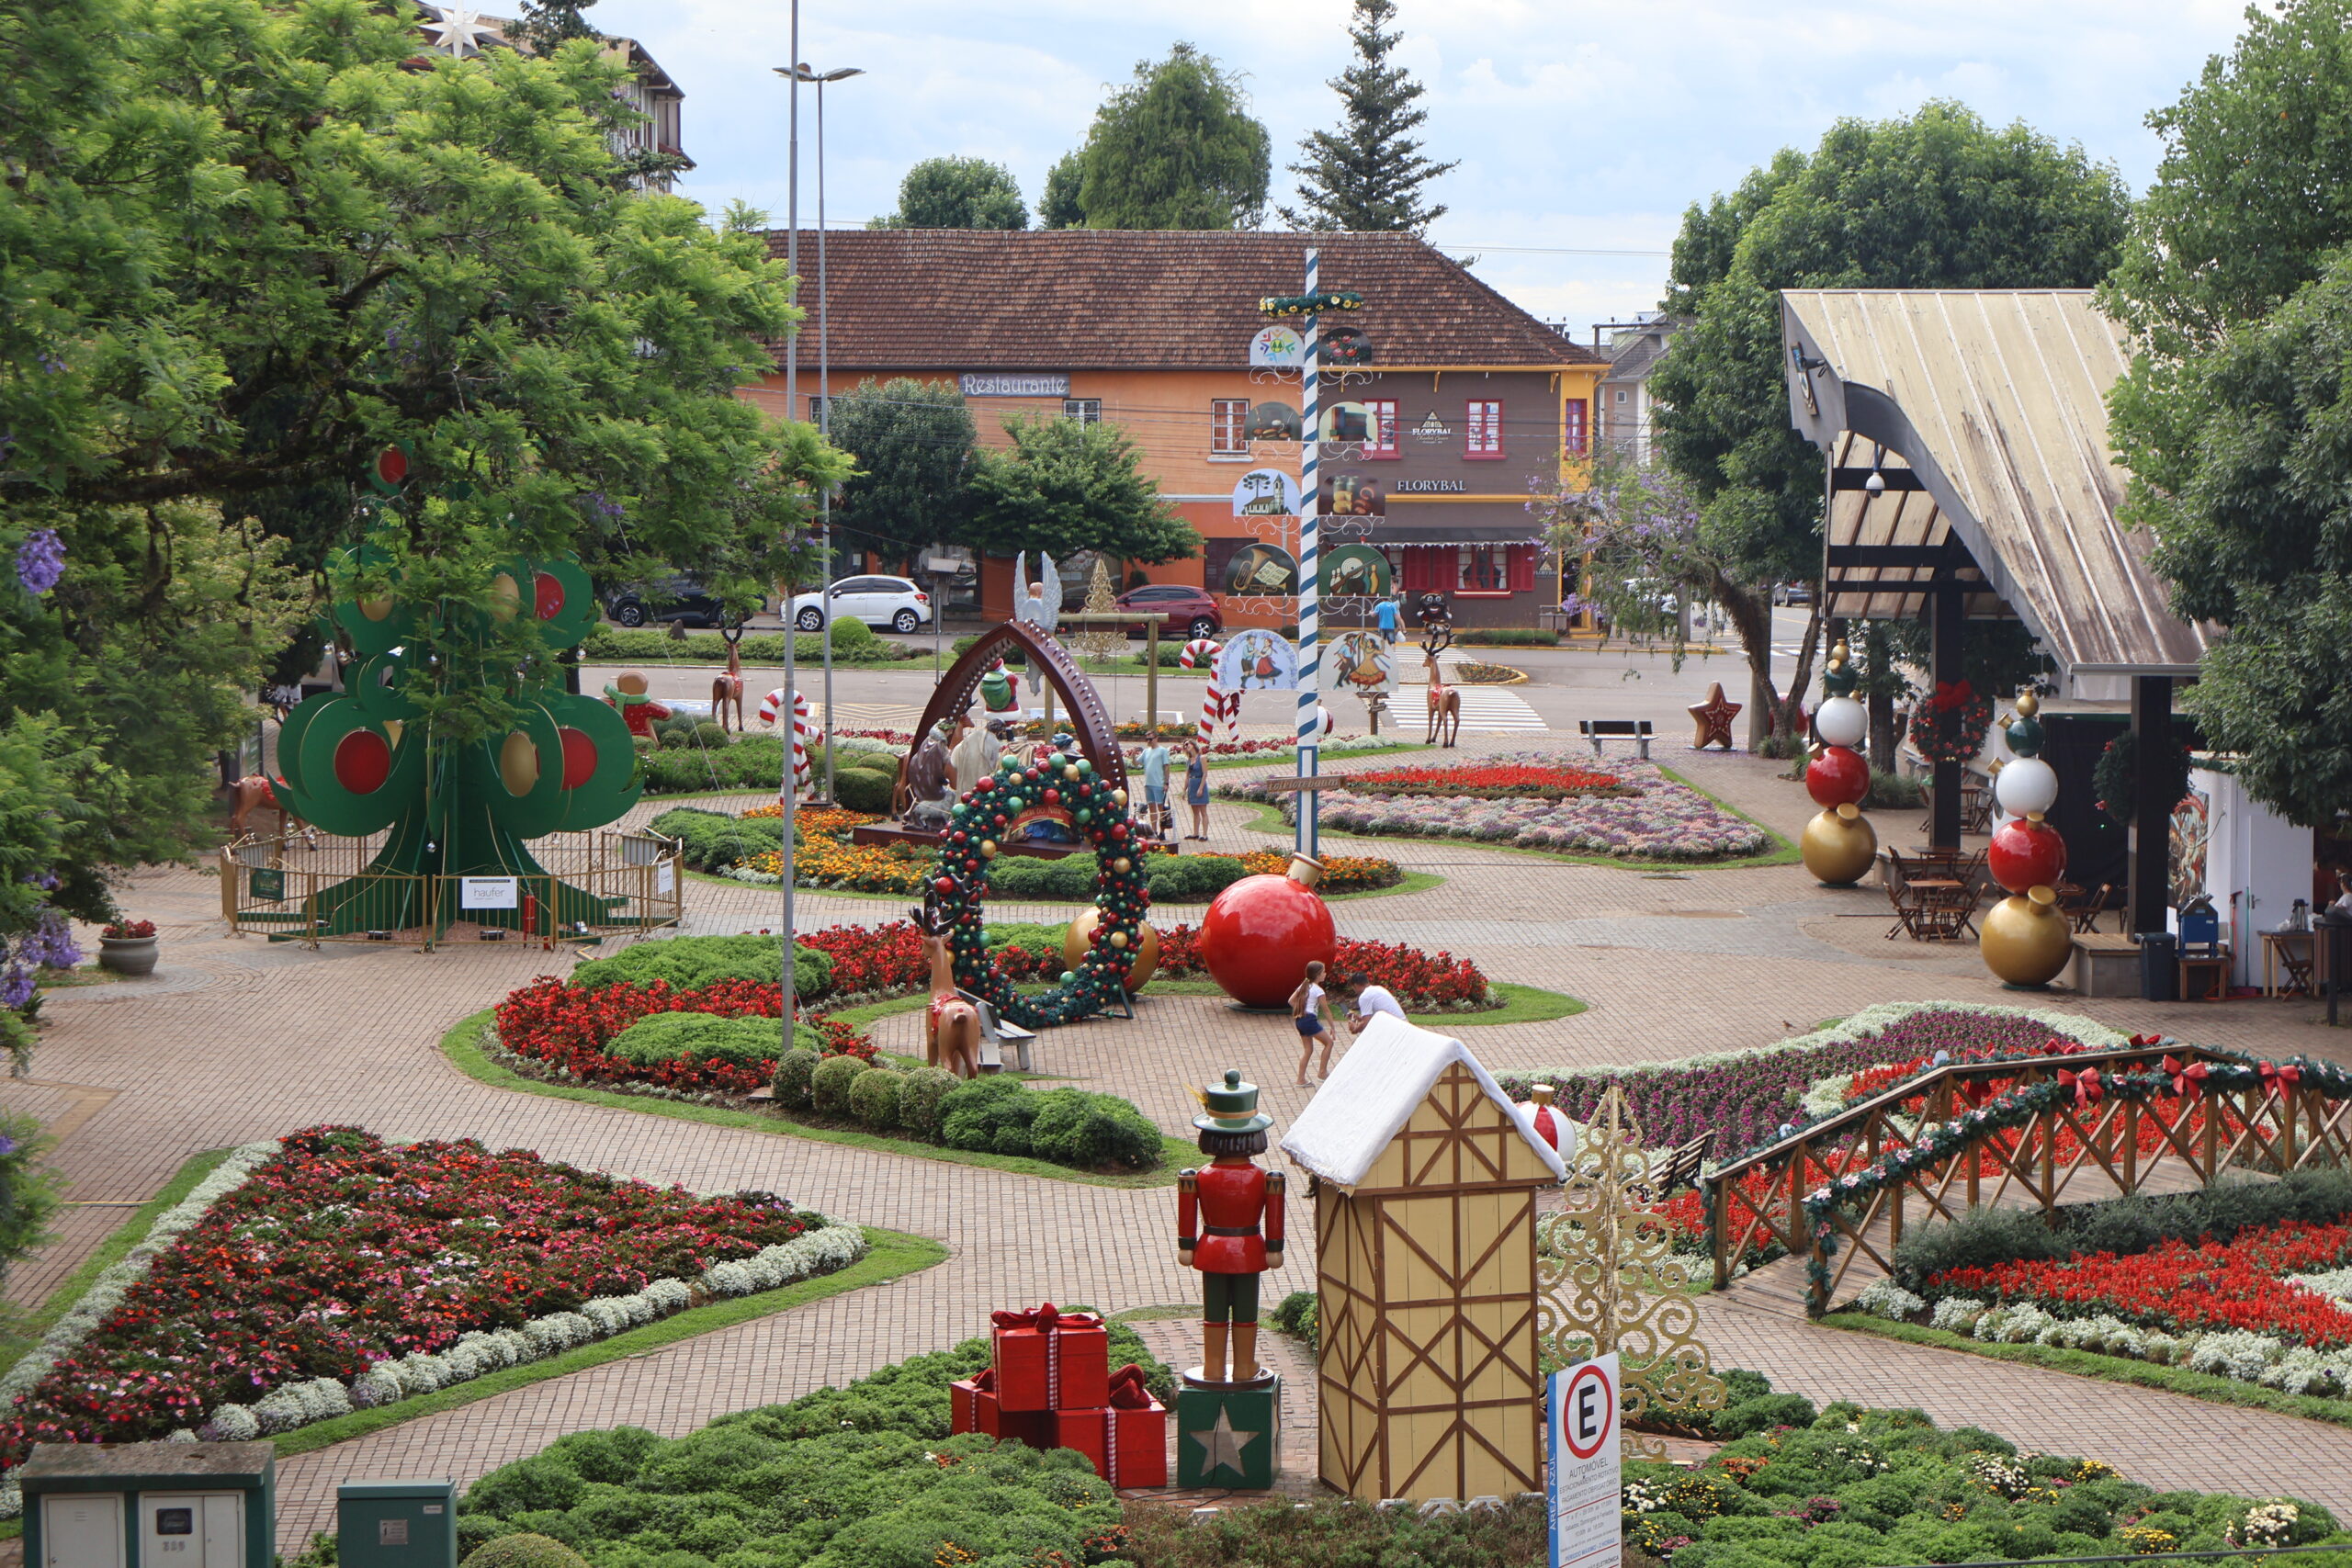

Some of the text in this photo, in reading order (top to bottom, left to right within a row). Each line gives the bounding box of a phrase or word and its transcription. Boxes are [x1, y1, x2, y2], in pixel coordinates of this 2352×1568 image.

[963, 374, 1066, 395] Restaurante
[1396, 479, 1467, 491] FLORYBAL
[473, 887, 505, 897] haufer
[1579, 1384, 1597, 1439] E
[1569, 1457, 1608, 1478] AUTOMÓVEL
